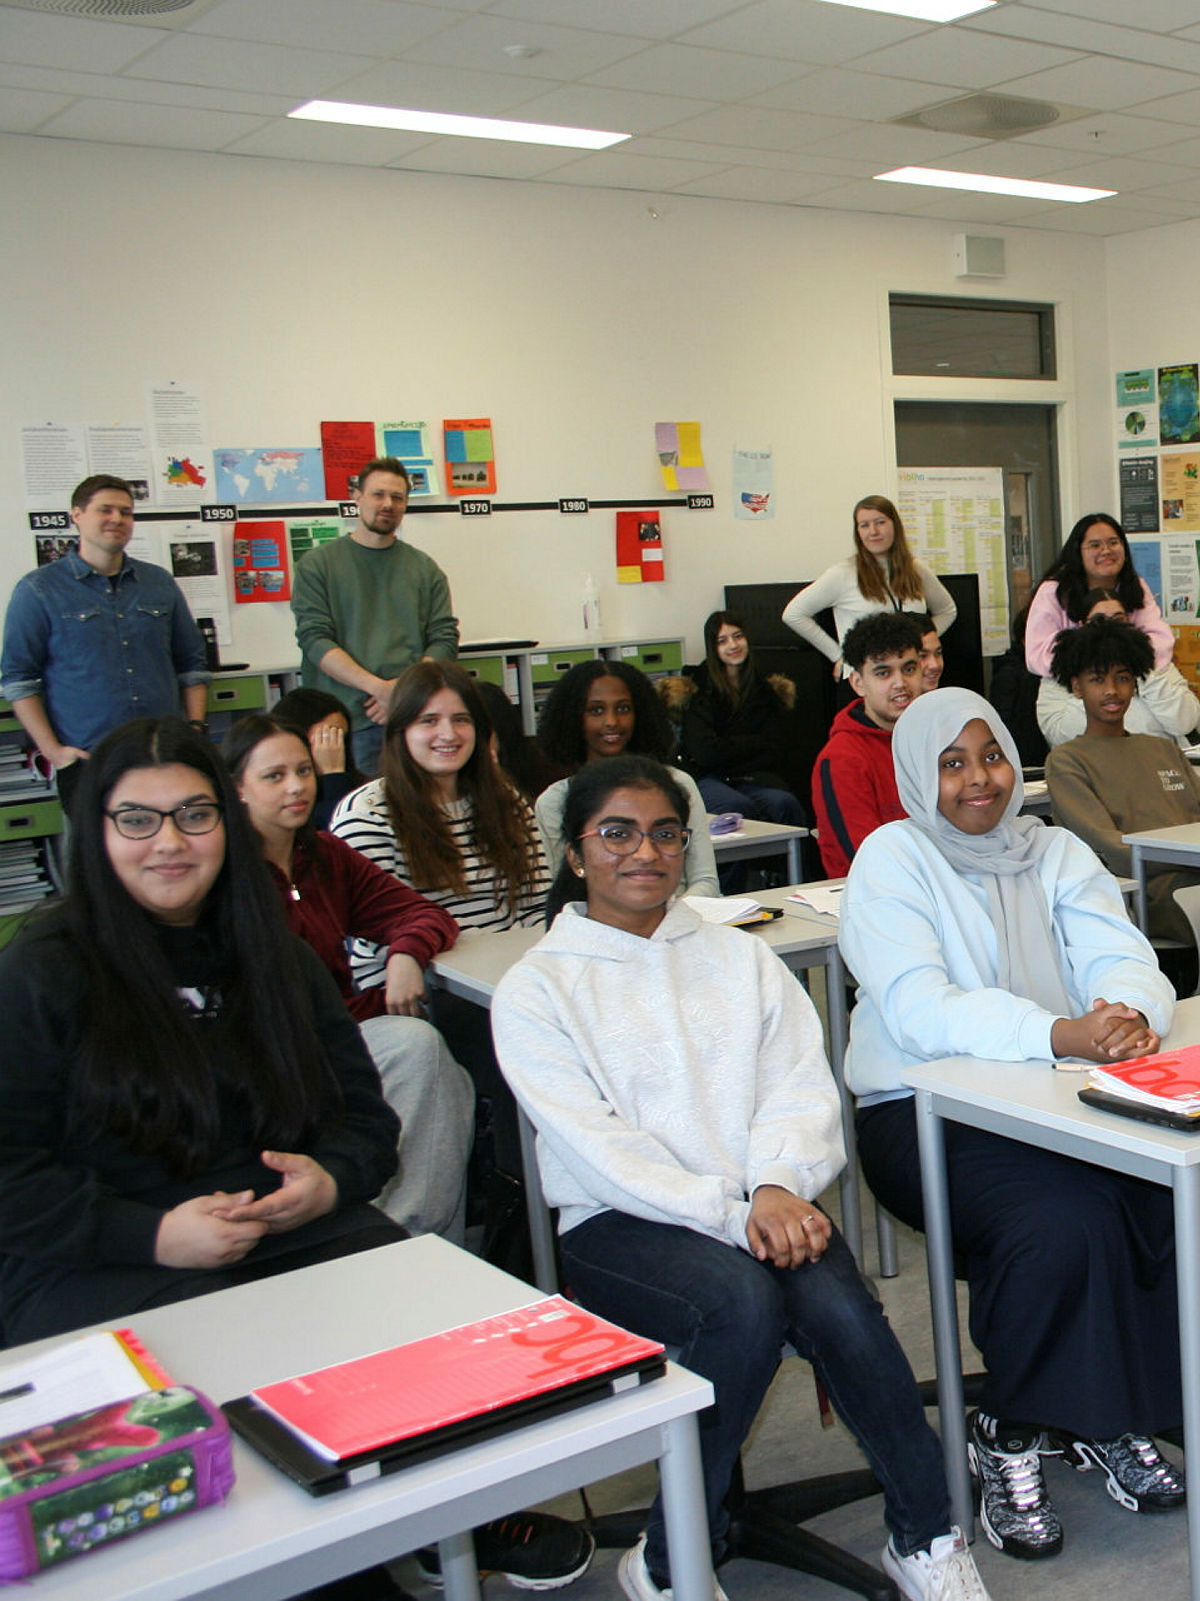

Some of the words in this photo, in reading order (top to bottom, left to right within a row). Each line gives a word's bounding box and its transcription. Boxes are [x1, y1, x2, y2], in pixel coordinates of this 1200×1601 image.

[463, 503, 489, 513] 1970
[562, 501, 586, 511] 1980
[690, 498, 712, 508] 1990
[205, 508, 235, 519] 1950
[33, 515, 67, 528] 1945
